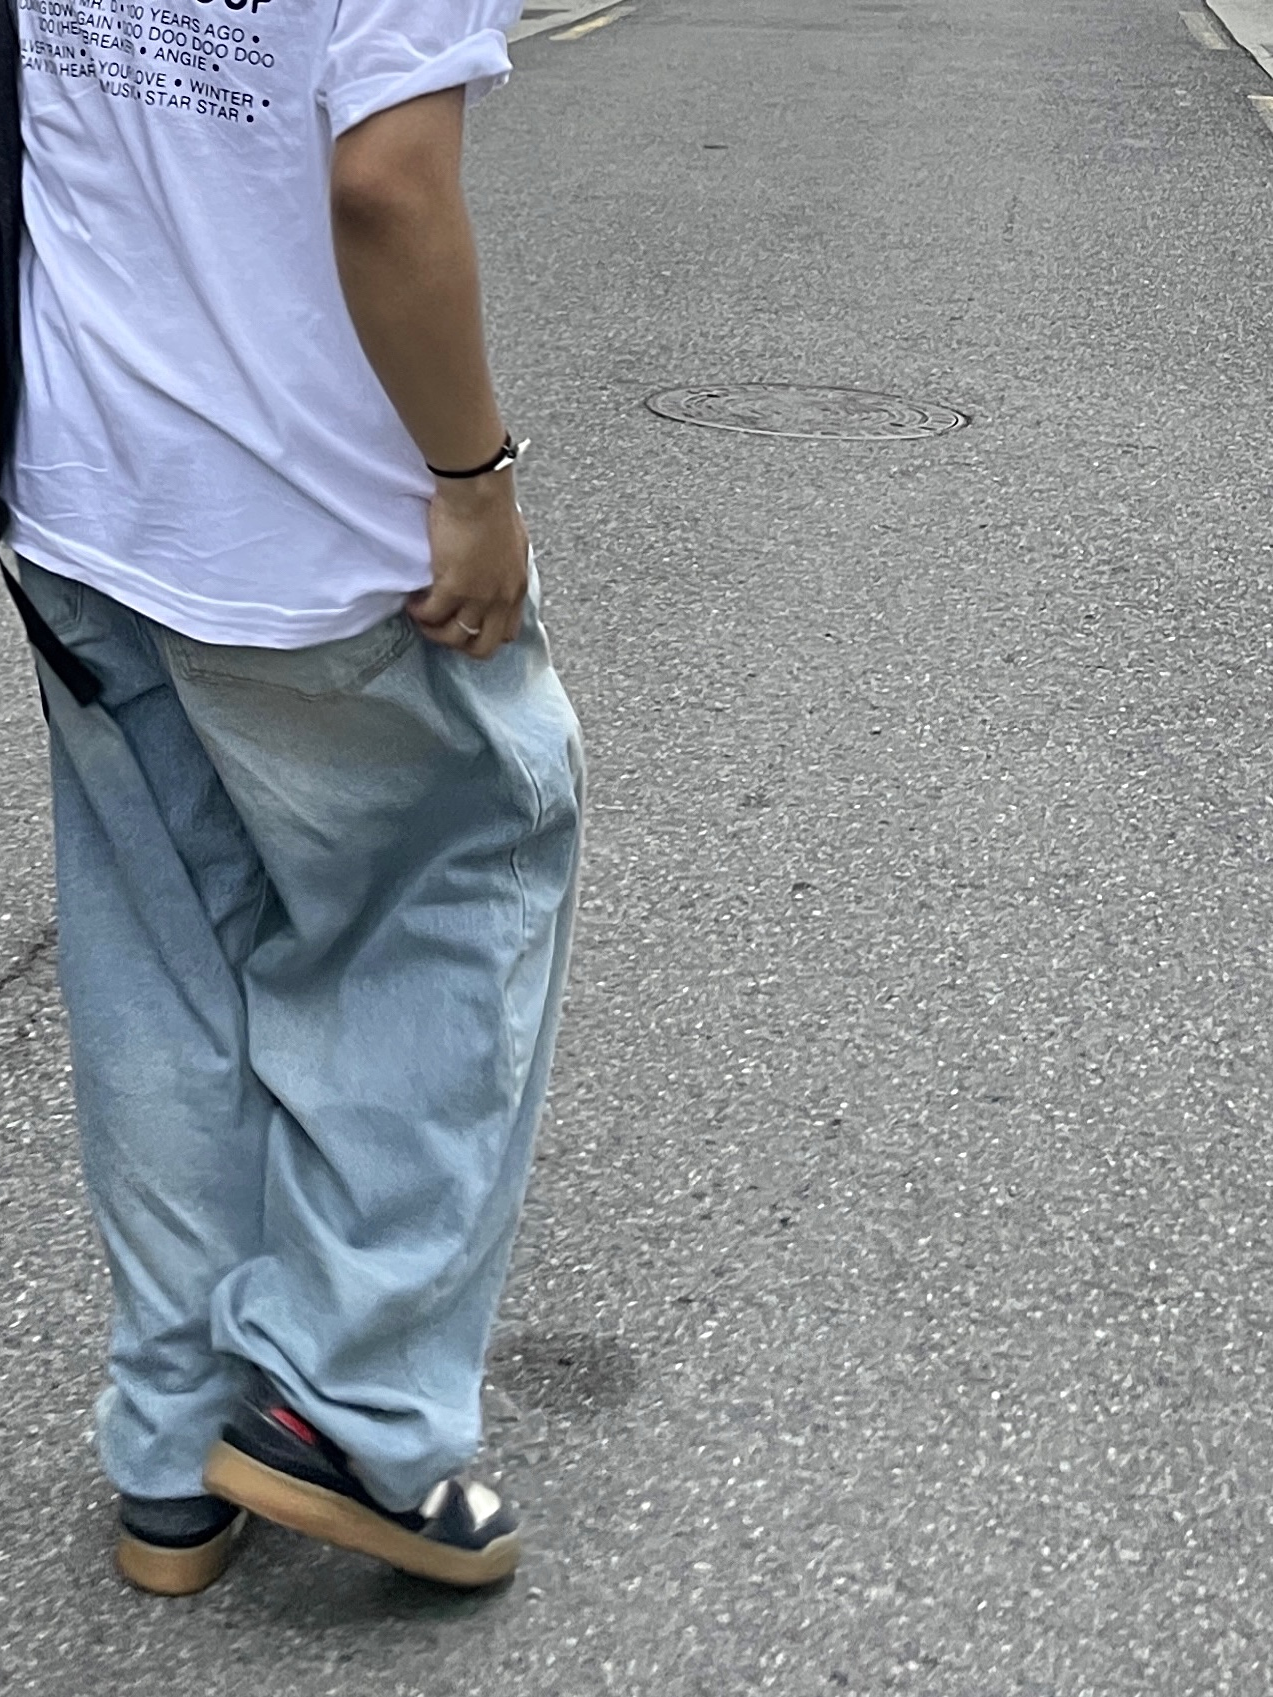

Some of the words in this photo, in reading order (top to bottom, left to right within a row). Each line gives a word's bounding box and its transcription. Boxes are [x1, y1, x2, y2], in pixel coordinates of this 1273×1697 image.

[150, 7, 201, 34] YEARS
[204, 24, 245, 44] AGO
[148, 26, 187, 47] DOO
[192, 36, 228, 59] DOO
[234, 46, 275, 69] DOO
[154, 47, 207, 72] ANGIE
[144, 89, 191, 110] STAR
[196, 99, 240, 123] STAR
[189, 77, 254, 108] WINTER
